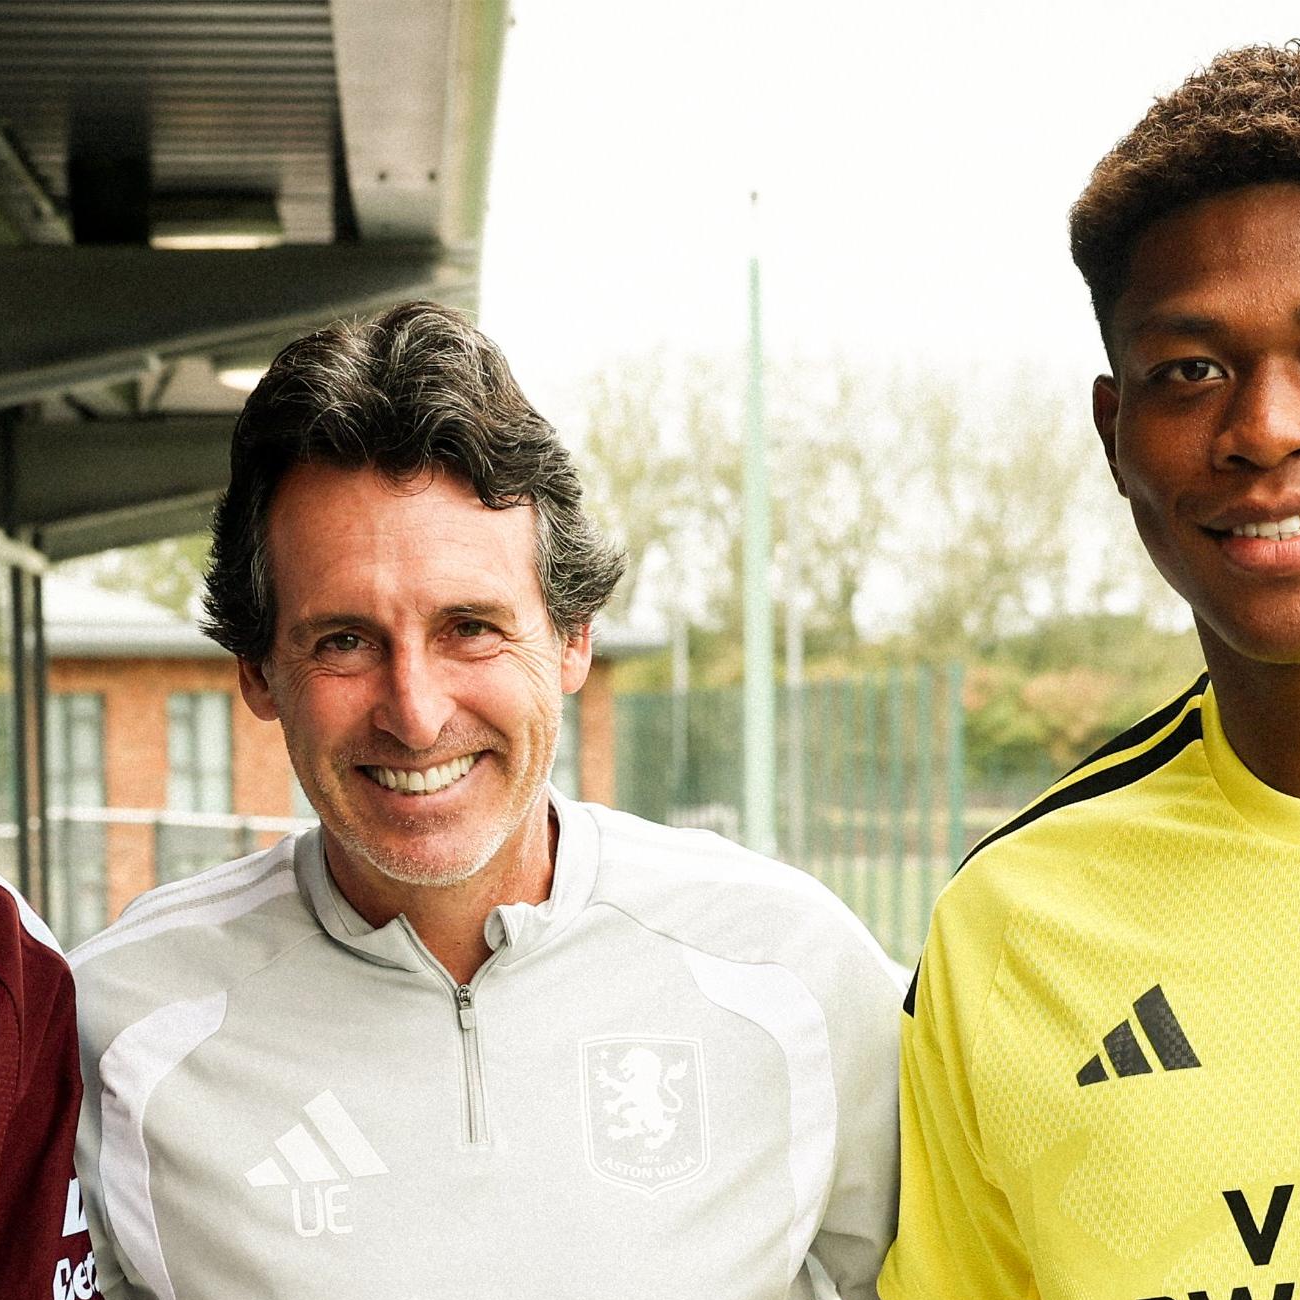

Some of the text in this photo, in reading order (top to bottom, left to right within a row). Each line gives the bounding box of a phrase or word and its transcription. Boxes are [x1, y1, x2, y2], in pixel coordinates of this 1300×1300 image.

[602, 1156, 697, 1178] ASTON VILLA
[291, 1184, 354, 1237] UE
